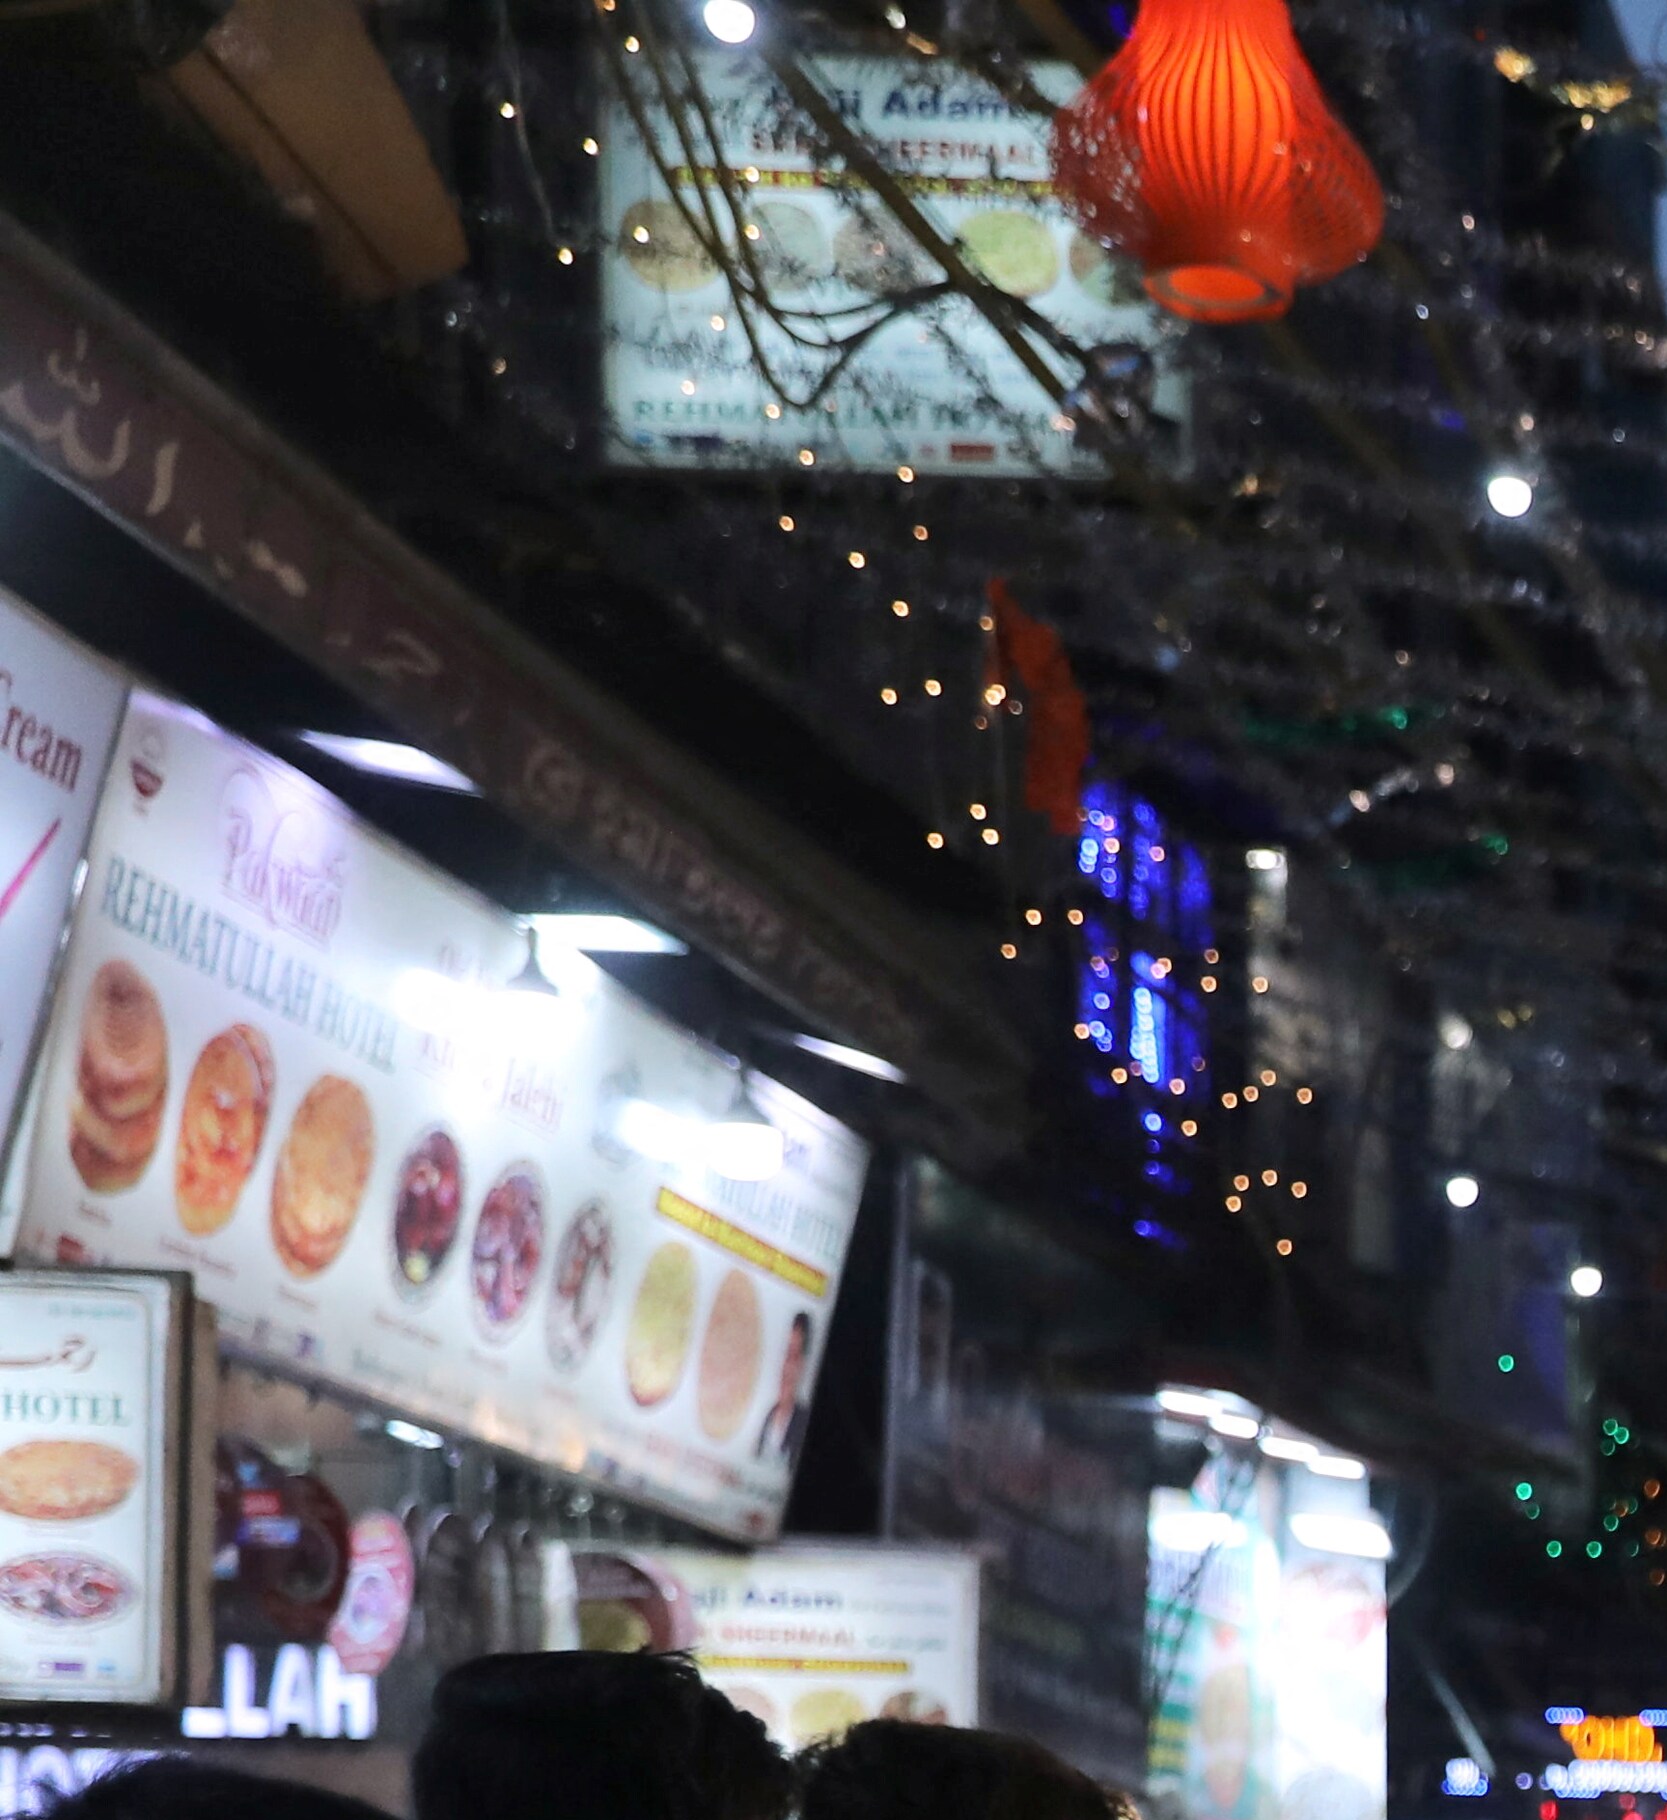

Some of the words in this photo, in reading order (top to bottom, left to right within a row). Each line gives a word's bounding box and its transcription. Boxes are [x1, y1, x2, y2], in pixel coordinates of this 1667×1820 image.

[100, 854, 319, 1025] REHMATULLAH
[0, 1388, 132, 1428] HOTEL
[181, 1642, 378, 1741] LAH
